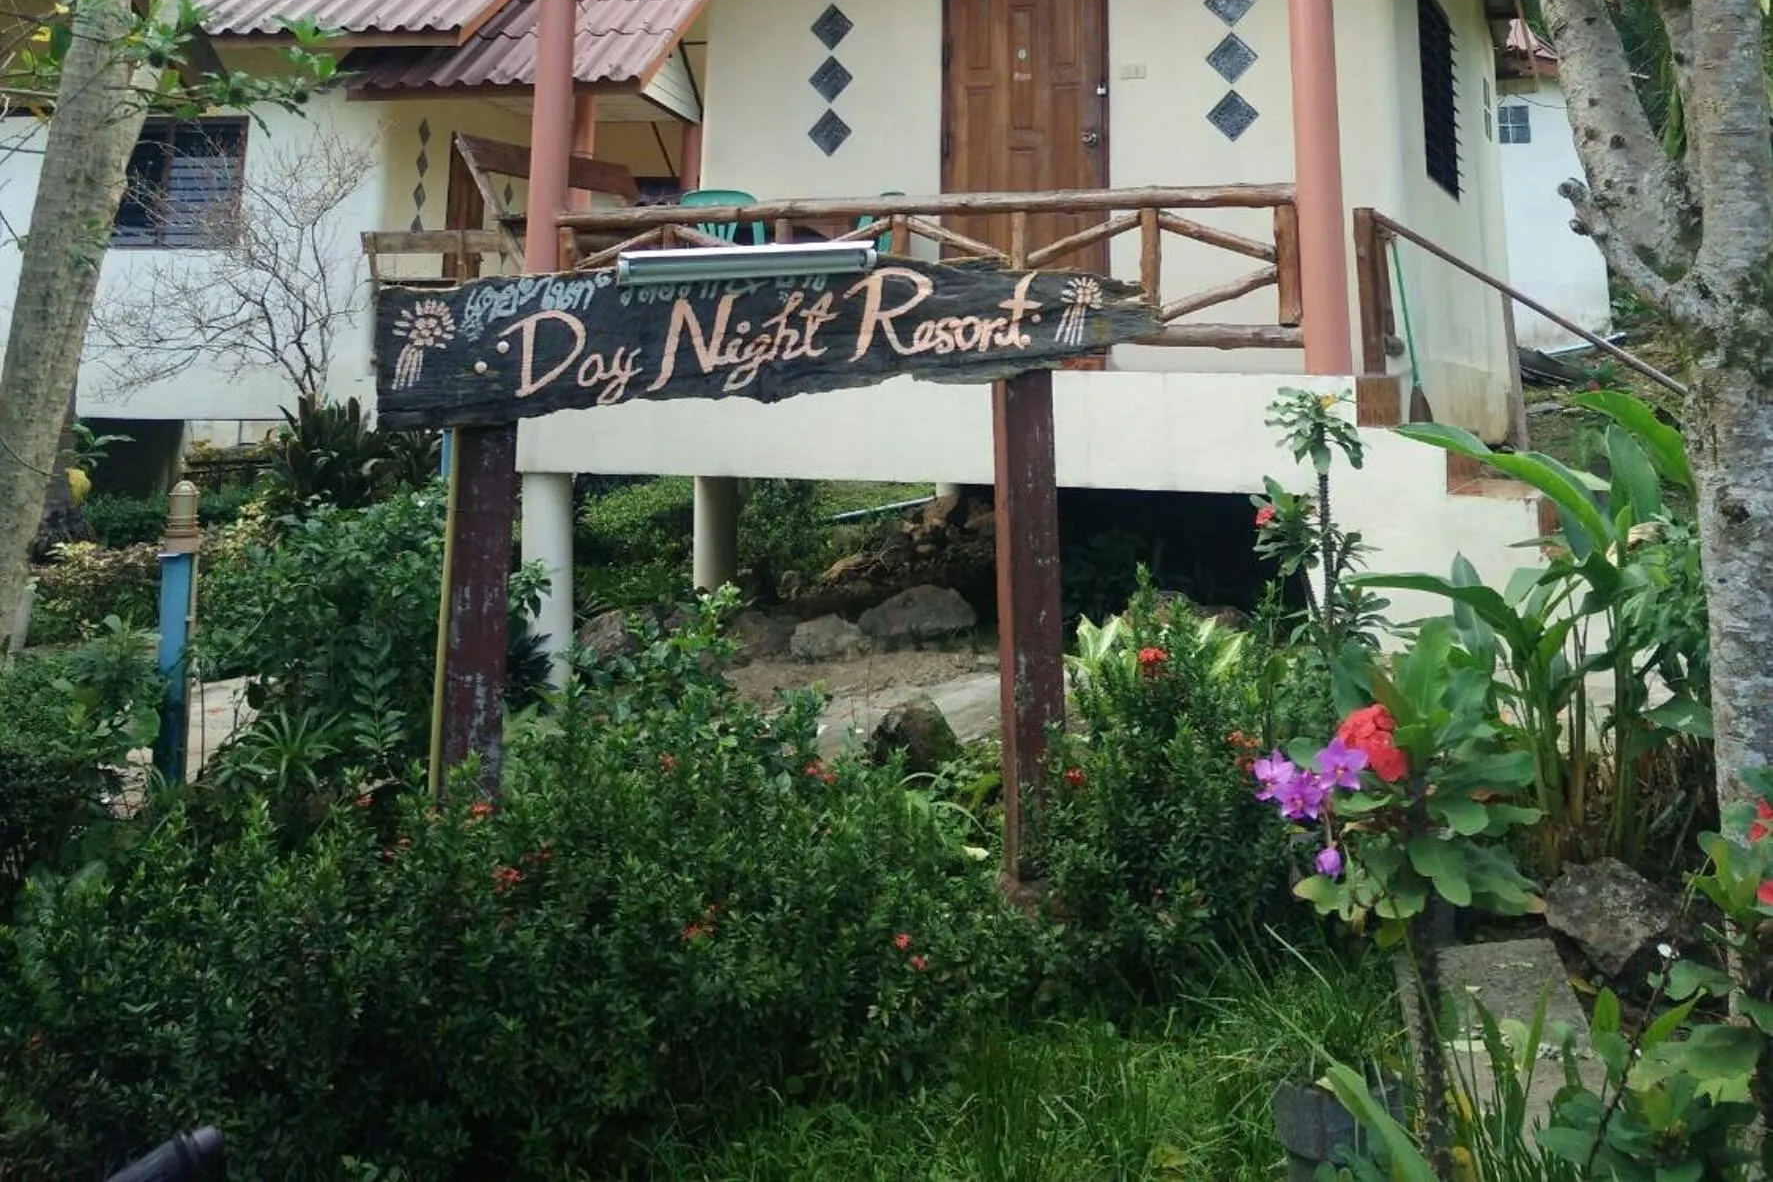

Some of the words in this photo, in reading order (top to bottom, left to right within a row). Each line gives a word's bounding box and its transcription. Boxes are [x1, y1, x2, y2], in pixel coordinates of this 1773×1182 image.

[498, 309, 643, 405] Day
[647, 290, 838, 393] Night
[843, 267, 1043, 363] Resort
